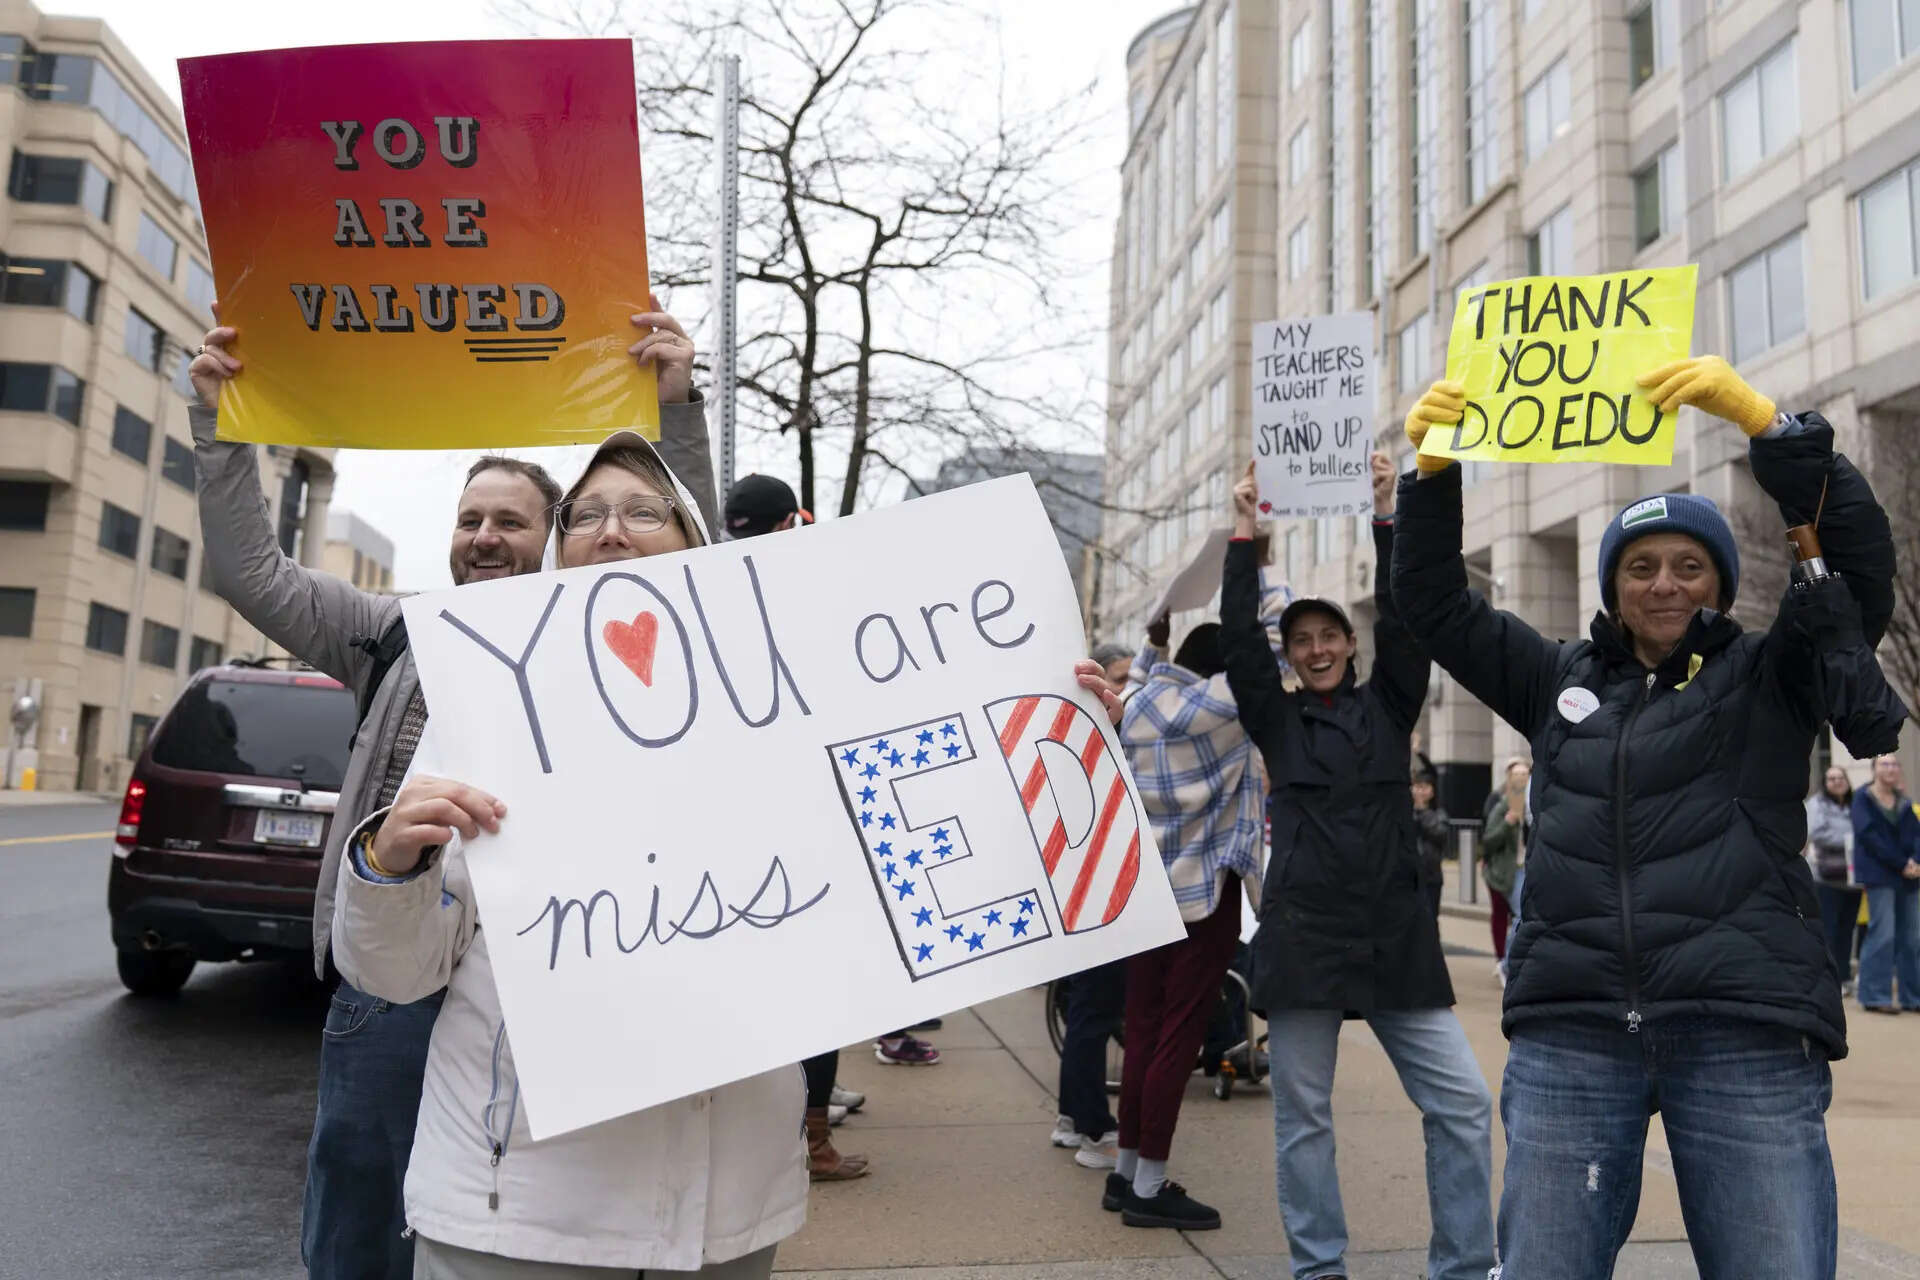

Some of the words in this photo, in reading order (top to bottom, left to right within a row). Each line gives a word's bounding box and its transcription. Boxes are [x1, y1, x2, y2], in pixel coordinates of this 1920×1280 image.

[321, 116, 480, 171] YOU
[333, 198, 488, 248] ARE
[290, 282, 566, 333] VALUED
[1468, 276, 1654, 340] THANK
[1273, 322, 1312, 350] MY
[1257, 345, 1364, 378] TEACHERS
[1496, 339, 1599, 393] YOU
[1256, 377, 1328, 403] TAUGHT
[1339, 374, 1365, 397] ME
[1258, 421, 1322, 456] STAND
[1335, 415, 1363, 449] UP
[1291, 409, 1309, 425] to
[1287, 459, 1303, 478] to
[1309, 439, 1370, 477] bullies!
[439, 555, 811, 775] YOU
[853, 579, 1036, 683] are
[516, 852, 831, 970] miss
[825, 693, 1141, 983] ED
